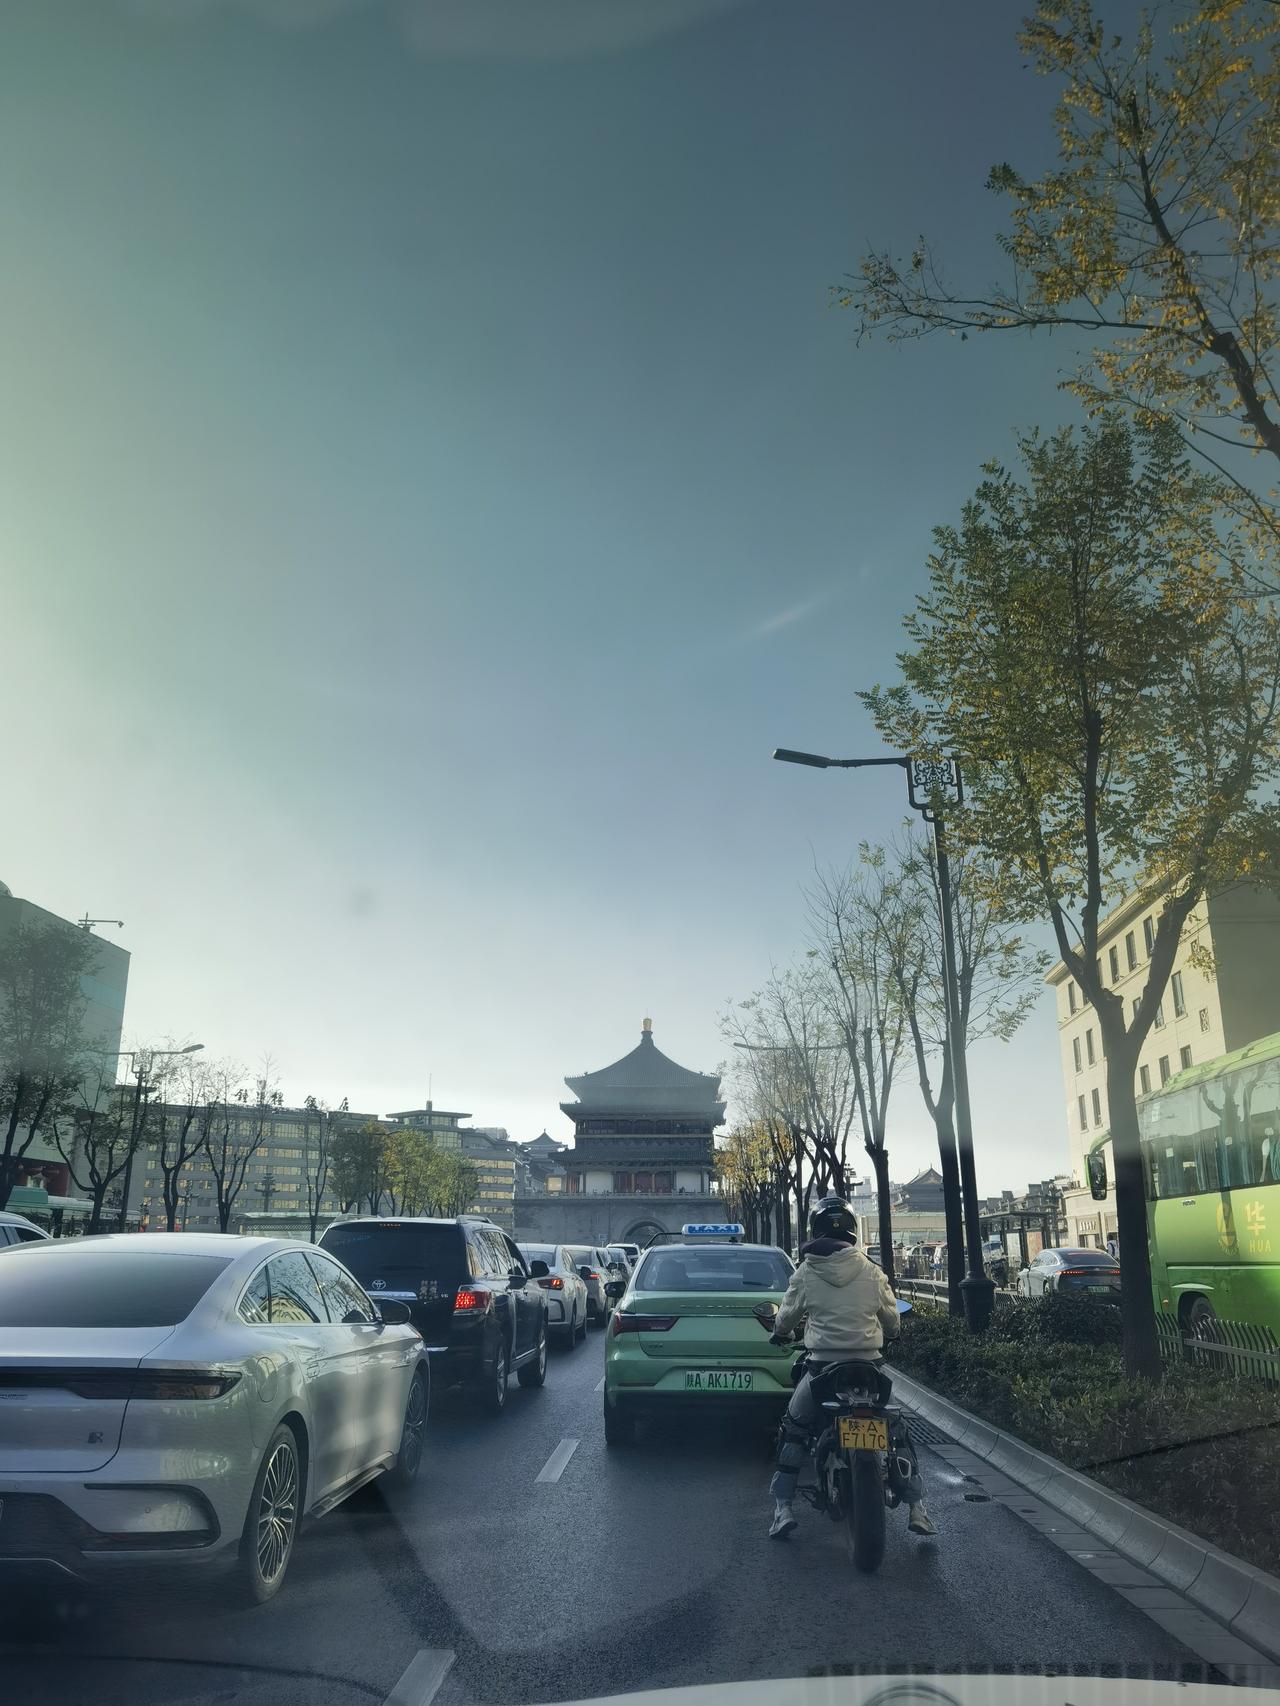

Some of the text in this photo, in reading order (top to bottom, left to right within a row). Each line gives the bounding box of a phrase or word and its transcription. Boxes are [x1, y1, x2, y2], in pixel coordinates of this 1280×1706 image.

[1244, 1200, 1266, 1236] 华
[1249, 1239, 1272, 1253] HUA
[842, 1432, 886, 1450] F717C
